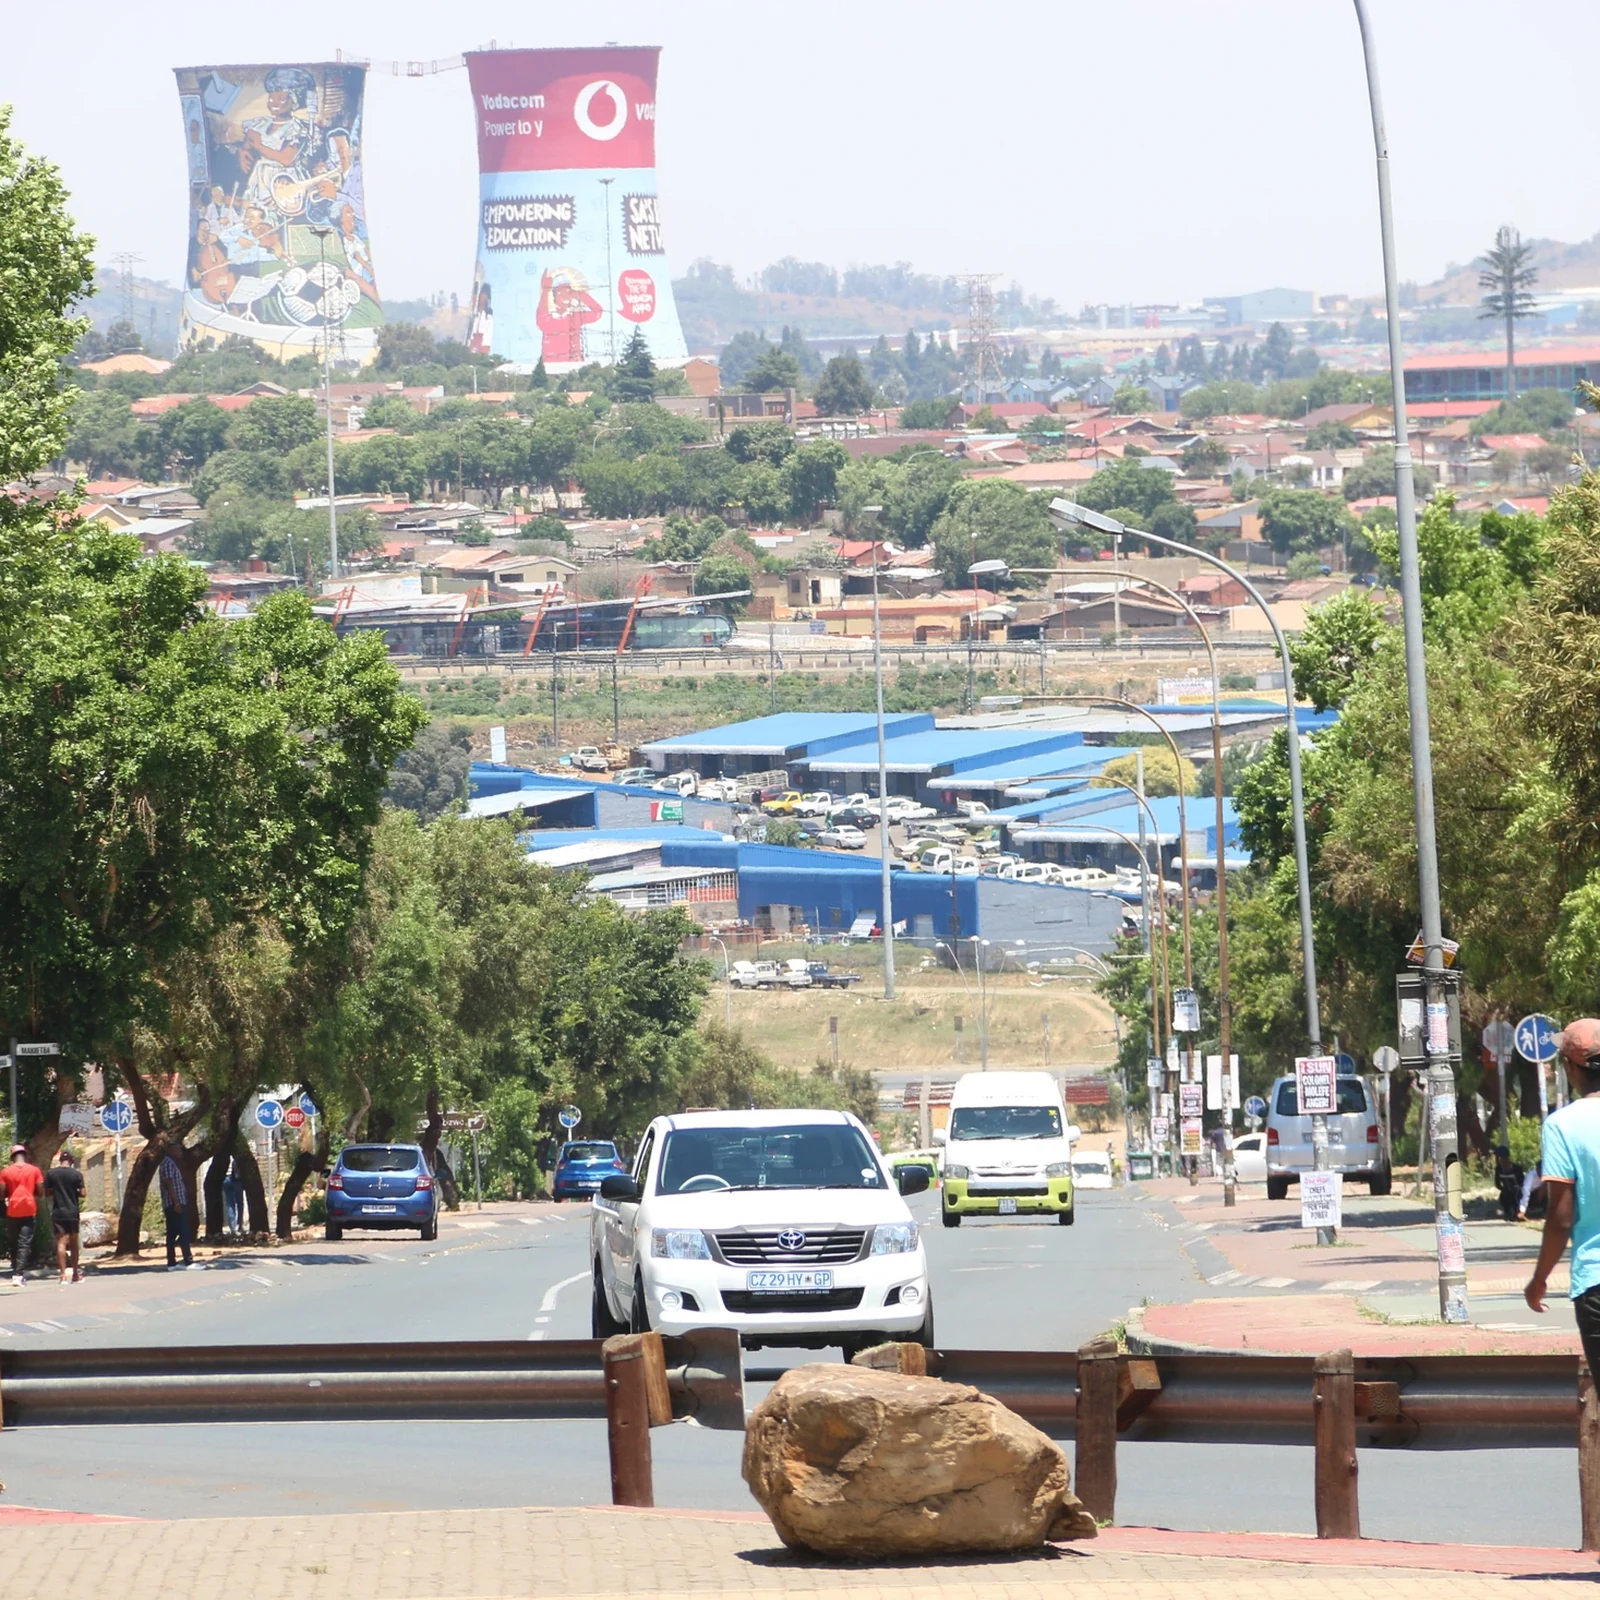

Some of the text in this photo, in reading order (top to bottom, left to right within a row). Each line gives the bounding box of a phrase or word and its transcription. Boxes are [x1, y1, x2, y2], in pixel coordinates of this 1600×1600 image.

[481, 94, 545, 110] Vodacom
[484, 121, 516, 137] Power
[484, 202, 572, 224] EMPOWERING
[487, 227, 561, 247] EDUCATION
[287, 1113, 304, 1122] STOP
[751, 1272, 830, 1286] CZ 29 HY GP
